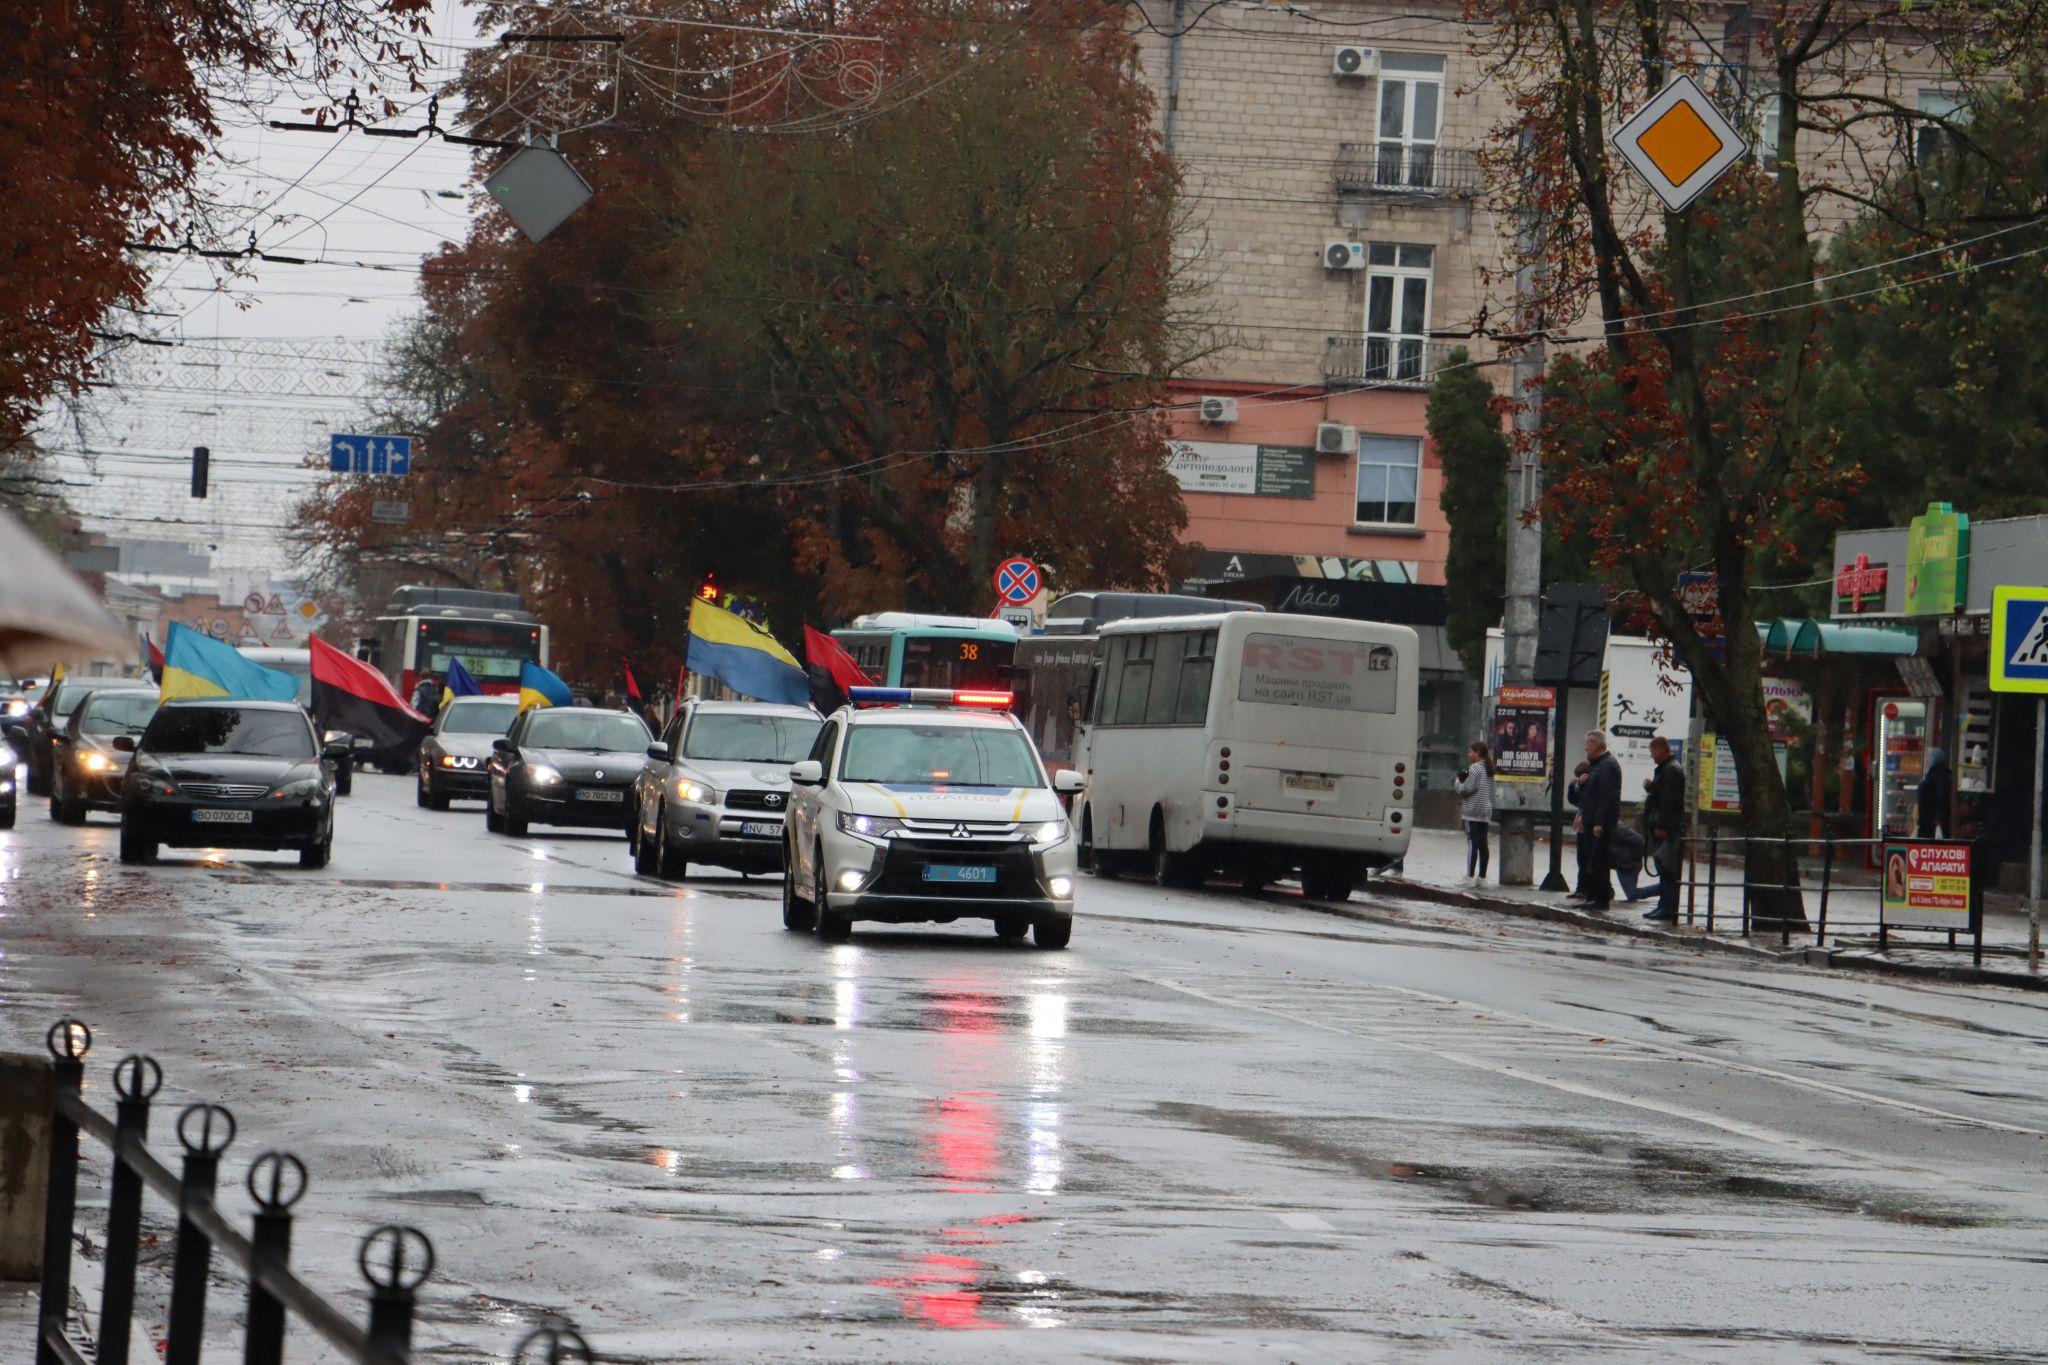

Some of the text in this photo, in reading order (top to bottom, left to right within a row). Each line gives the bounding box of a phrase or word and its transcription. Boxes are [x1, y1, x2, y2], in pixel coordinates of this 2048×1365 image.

[703, 586, 717, 599] 34
[959, 643, 979, 660] 38
[1244, 642, 1367, 677] RST
[467, 658, 484, 674] 35
[1255, 673, 1352, 691] Машини продають
[1254, 688, 1351, 704] на сайті RST.ua
[1497, 708, 1506, 716] 22
[1618, 727, 1650, 736] Укриття
[1515, 751, 1539, 761] БОБУЛ
[213, 811, 235, 821] 0700
[749, 824, 763, 833] NV
[1920, 848, 1966, 860] СЛУХОВІ
[1920, 861, 1966, 873] АПАРАТИ
[958, 867, 986, 880] 4601
